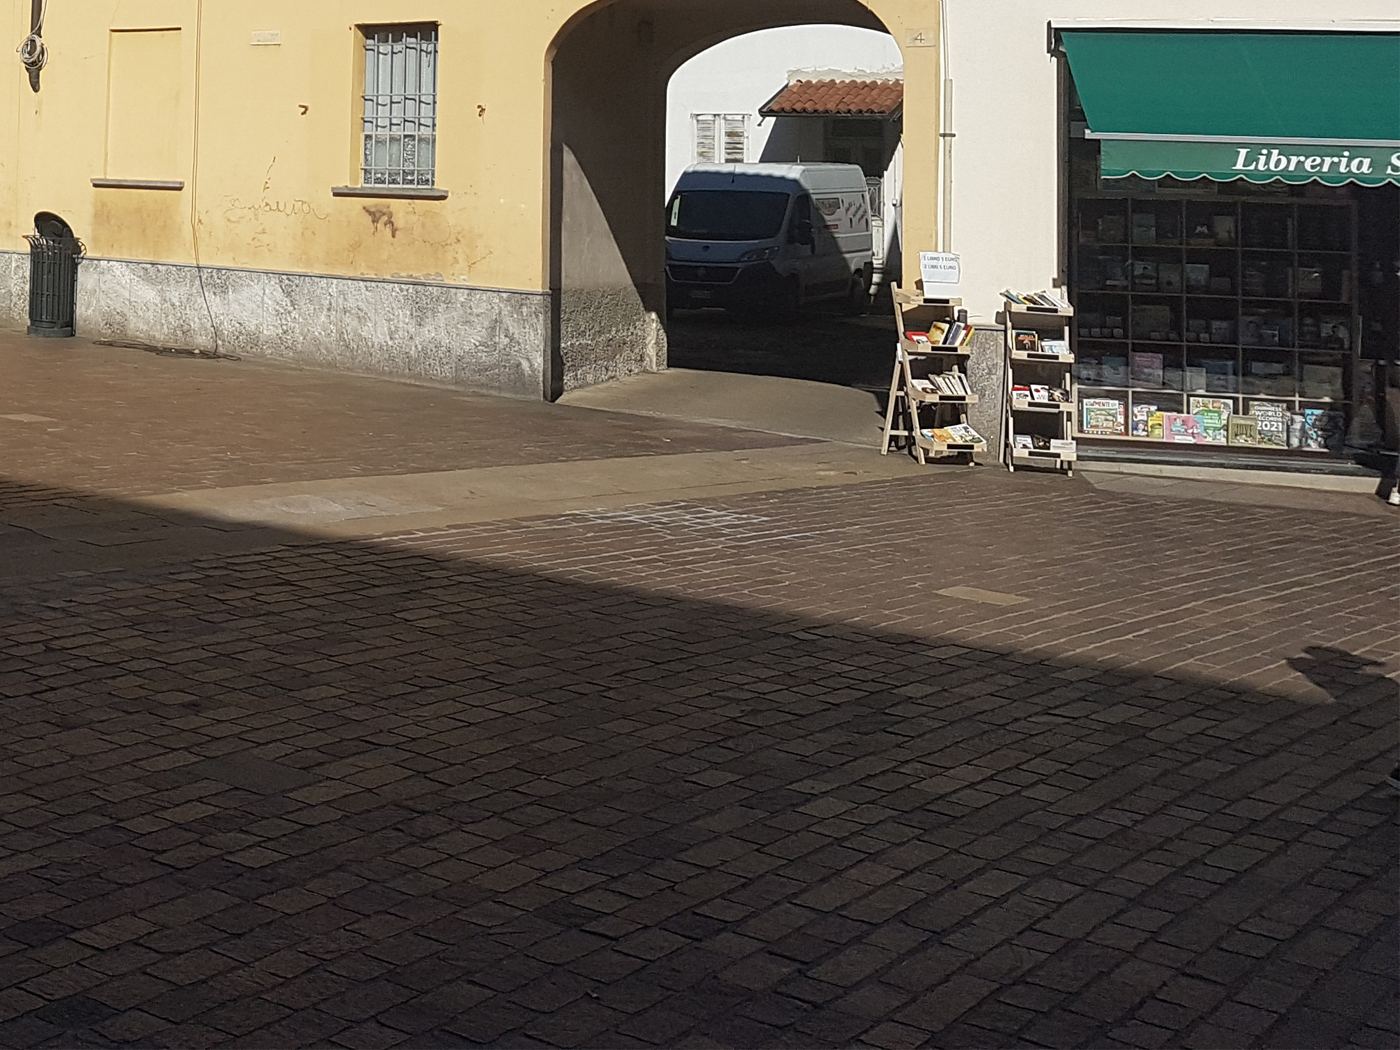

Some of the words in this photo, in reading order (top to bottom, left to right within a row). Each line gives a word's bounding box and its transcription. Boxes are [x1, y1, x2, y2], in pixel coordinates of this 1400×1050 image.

[914, 32, 925, 43] 4
[1231, 148, 1373, 174] Libreria
[1257, 421, 1282, 431] 2021
